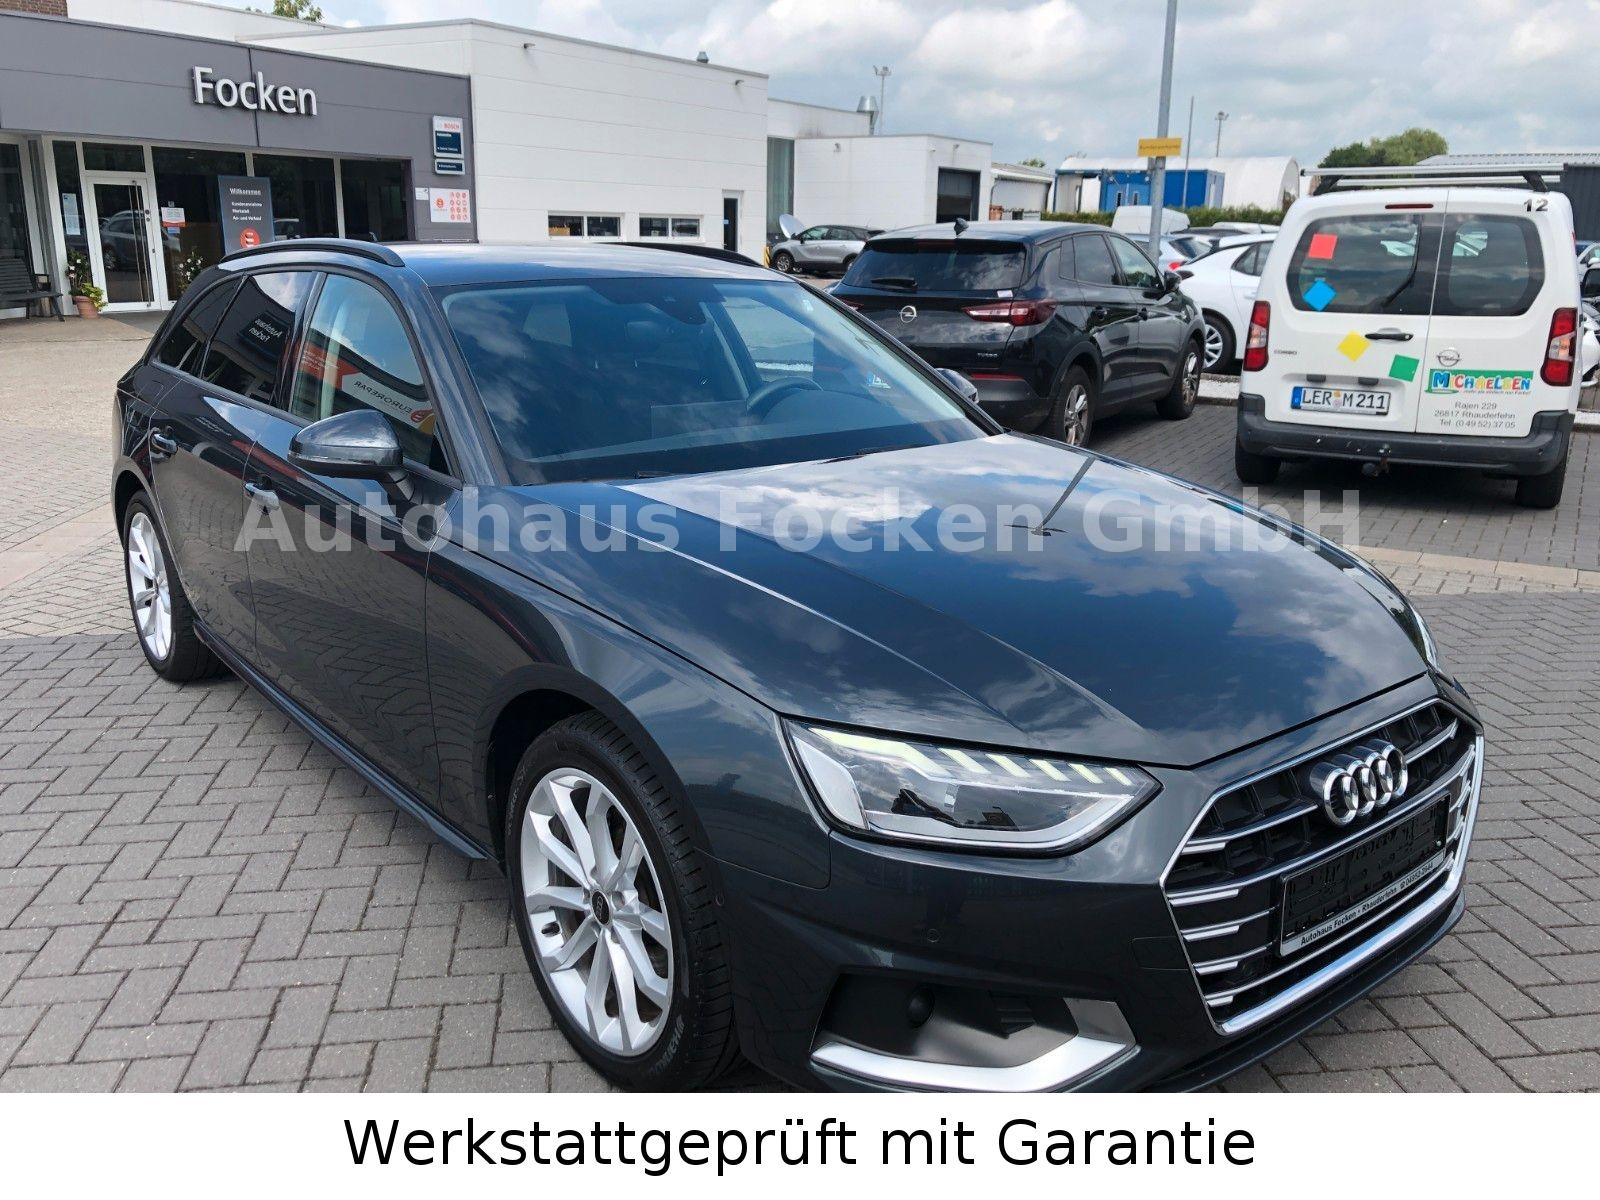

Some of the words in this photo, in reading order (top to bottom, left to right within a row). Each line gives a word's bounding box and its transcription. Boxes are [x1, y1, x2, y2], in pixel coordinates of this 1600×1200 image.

[192, 65, 318, 116] Focken
[229, 188, 262, 196] Willkommen
[1523, 198, 1549, 212] 12
[1301, 389, 1332, 405] LER
[1356, 393, 1386, 410] 211
[1455, 401, 1479, 411] Rajen
[1481, 402, 1497, 410] 229
[1434, 409, 1460, 417] 26817
[1462, 410, 1516, 419] Rhauderfehn
[1300, 922, 1333, 946] Autohaus
[1334, 911, 1357, 929] Focken
